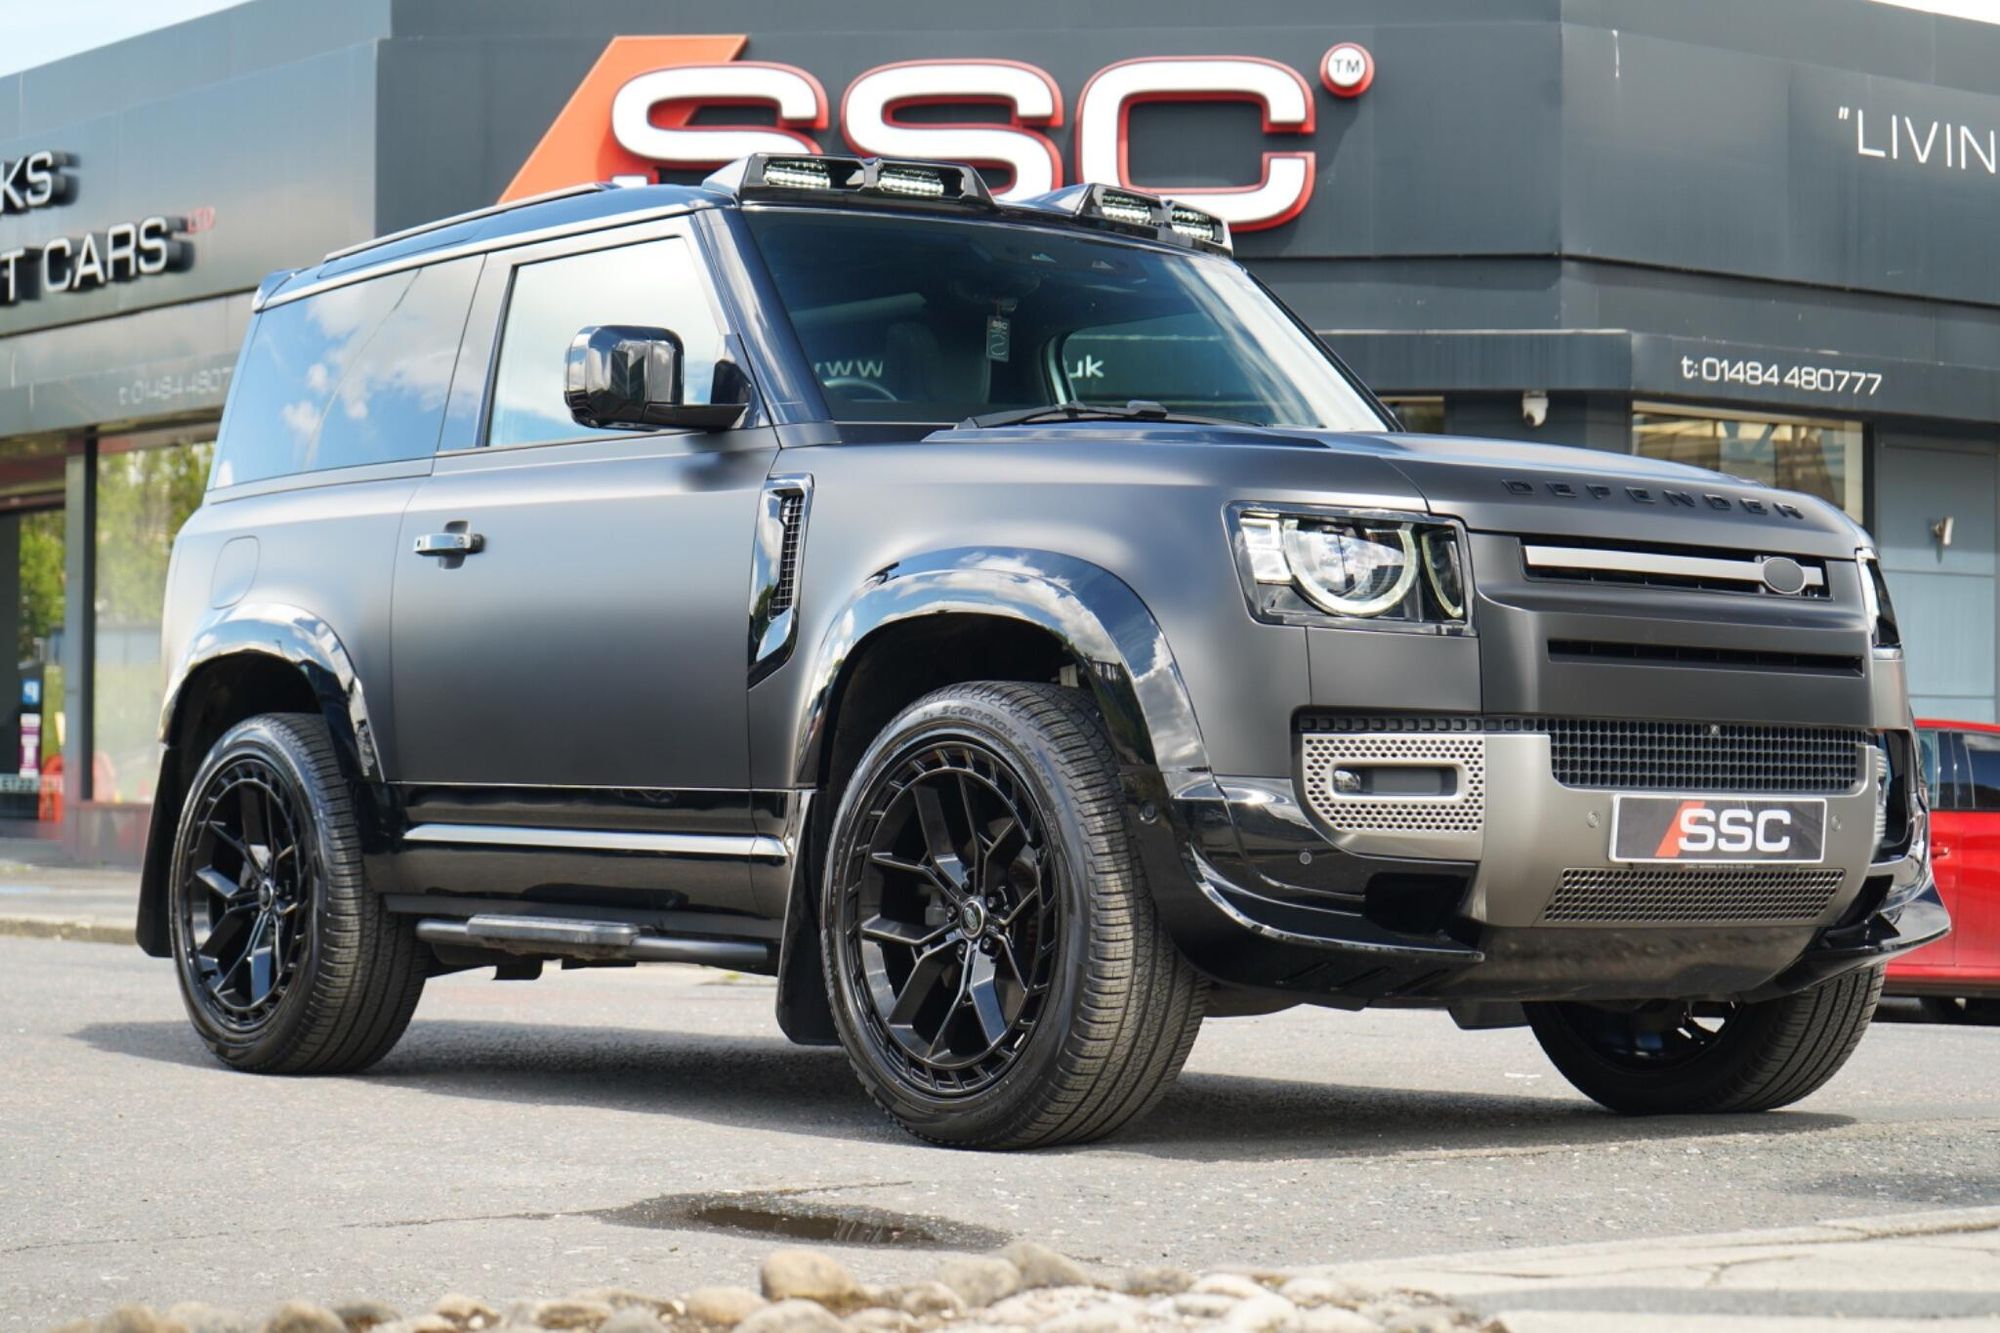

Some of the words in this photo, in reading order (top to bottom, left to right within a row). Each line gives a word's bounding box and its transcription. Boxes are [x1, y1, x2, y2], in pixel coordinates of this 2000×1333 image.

[611, 55, 1316, 232] SSC
[1334, 59, 1361, 74] TM
[43, 216, 168, 292] CARS
[814, 360, 884, 378] ww
[1783, 366, 1883, 396] 480777
[1502, 479, 1804, 520] DEFENDER
[939, 705, 1018, 740] SCORPION
[1678, 808, 1792, 853] SSC
